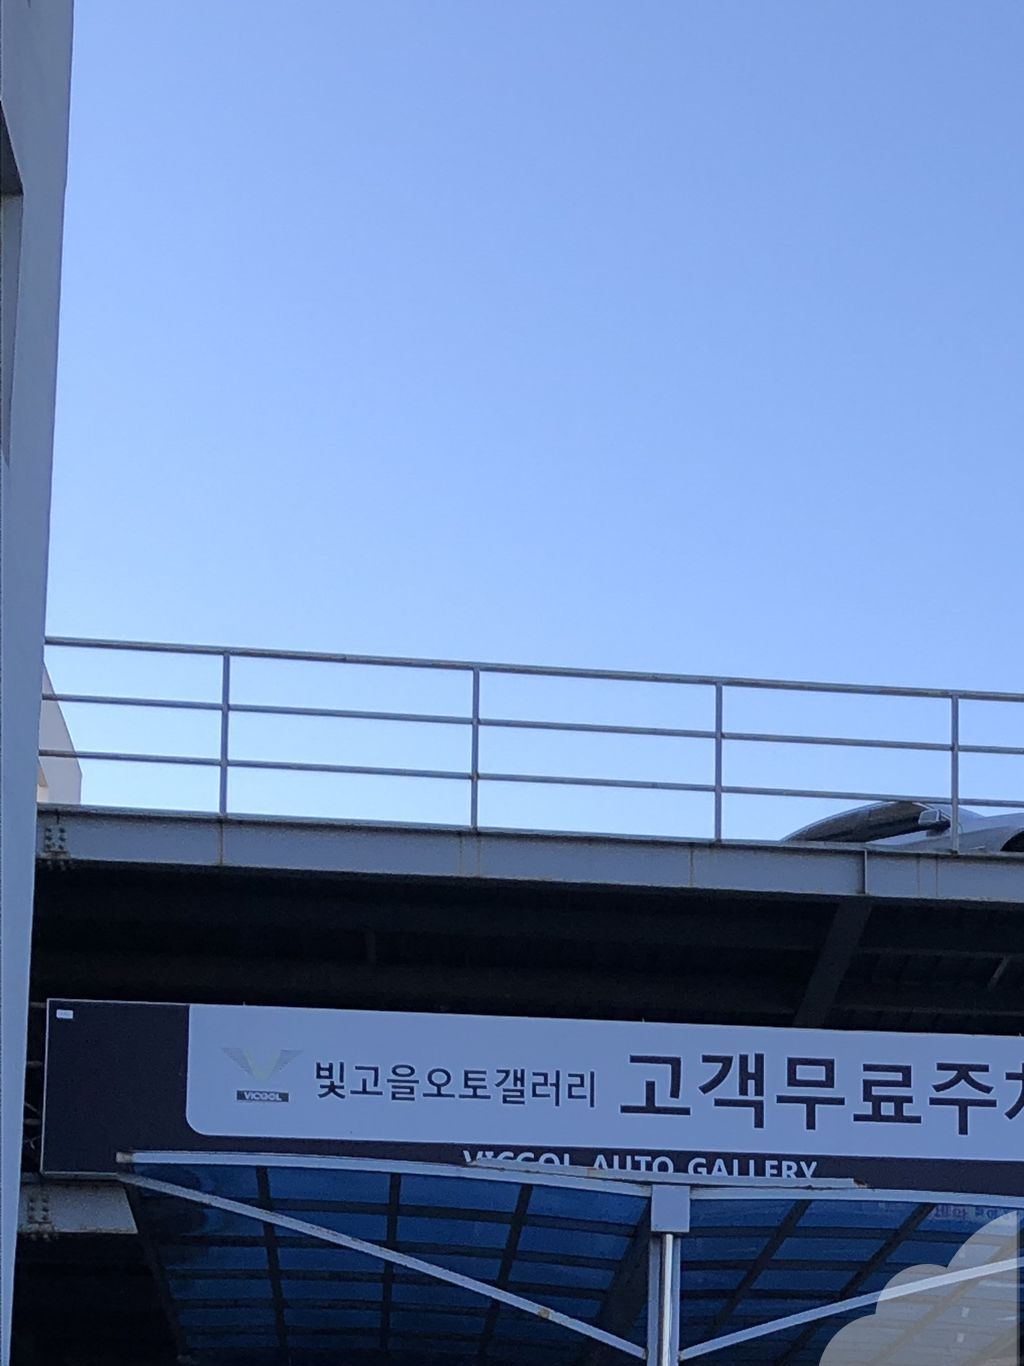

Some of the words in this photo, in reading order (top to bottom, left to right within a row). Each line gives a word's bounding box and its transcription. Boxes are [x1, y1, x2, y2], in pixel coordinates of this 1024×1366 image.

[315, 1061, 596, 1108] 빛고을오토갤러리
[593, 1154, 674, 1173] AUTO
[688, 1157, 817, 1179] GALLERY
